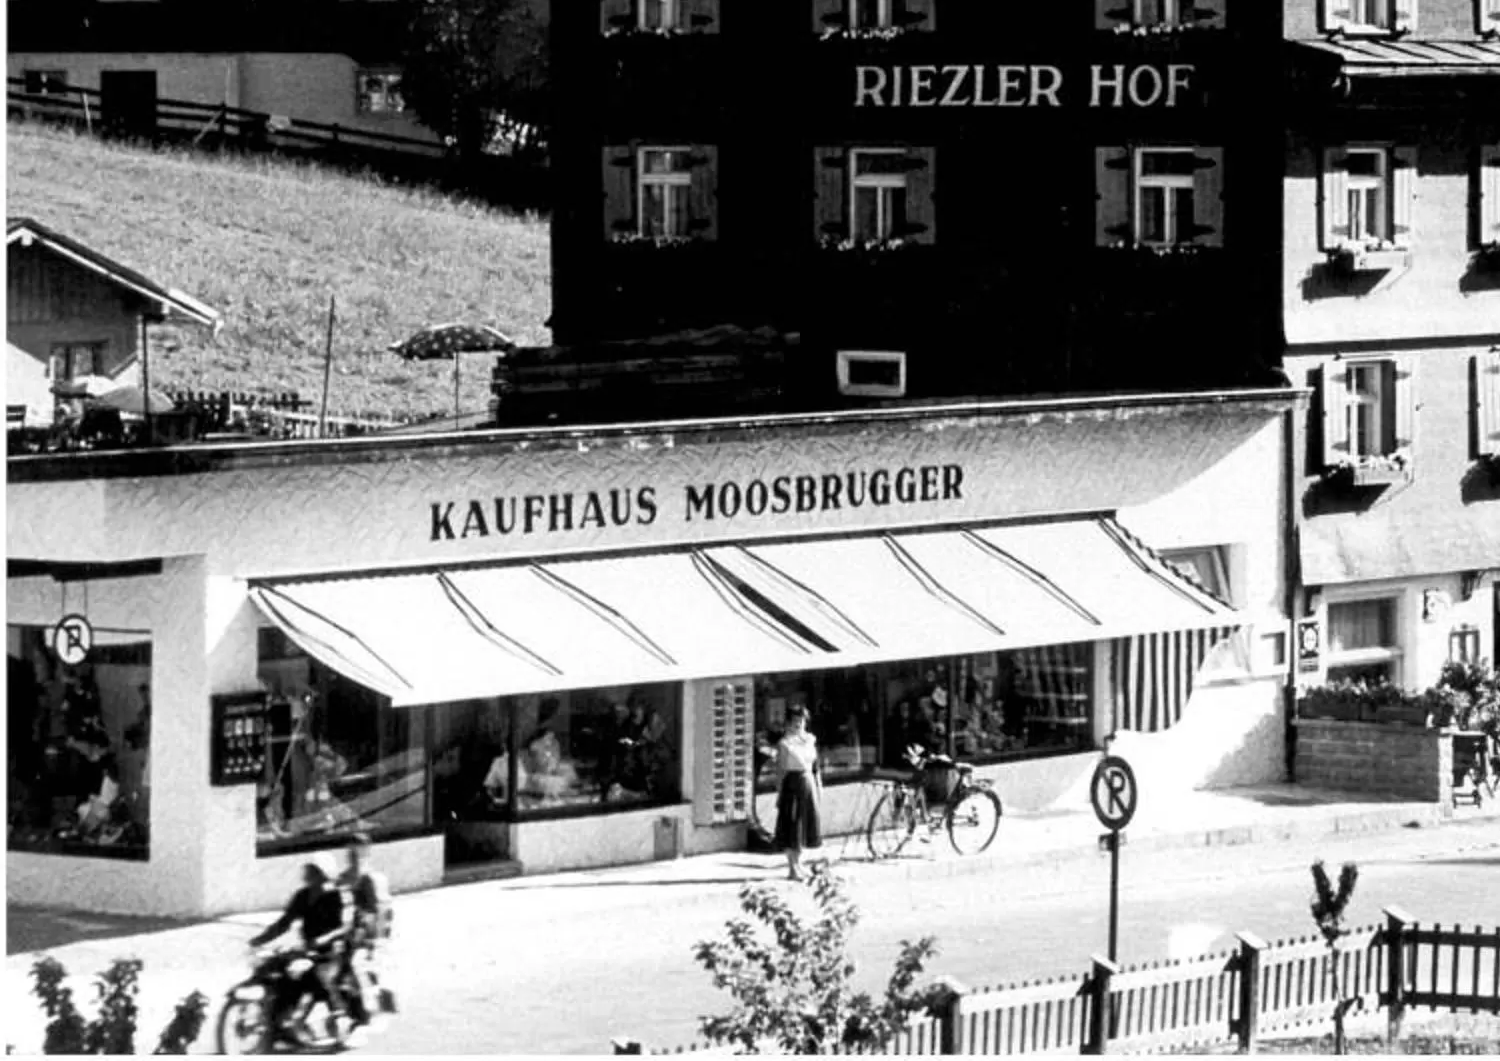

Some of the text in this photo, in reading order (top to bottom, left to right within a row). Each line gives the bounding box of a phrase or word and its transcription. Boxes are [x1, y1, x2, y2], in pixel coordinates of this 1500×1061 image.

[854, 64, 1196, 107] RIEZLER HOF
[430, 464, 965, 541] KAUFHAUS MOOSBRUGGER
